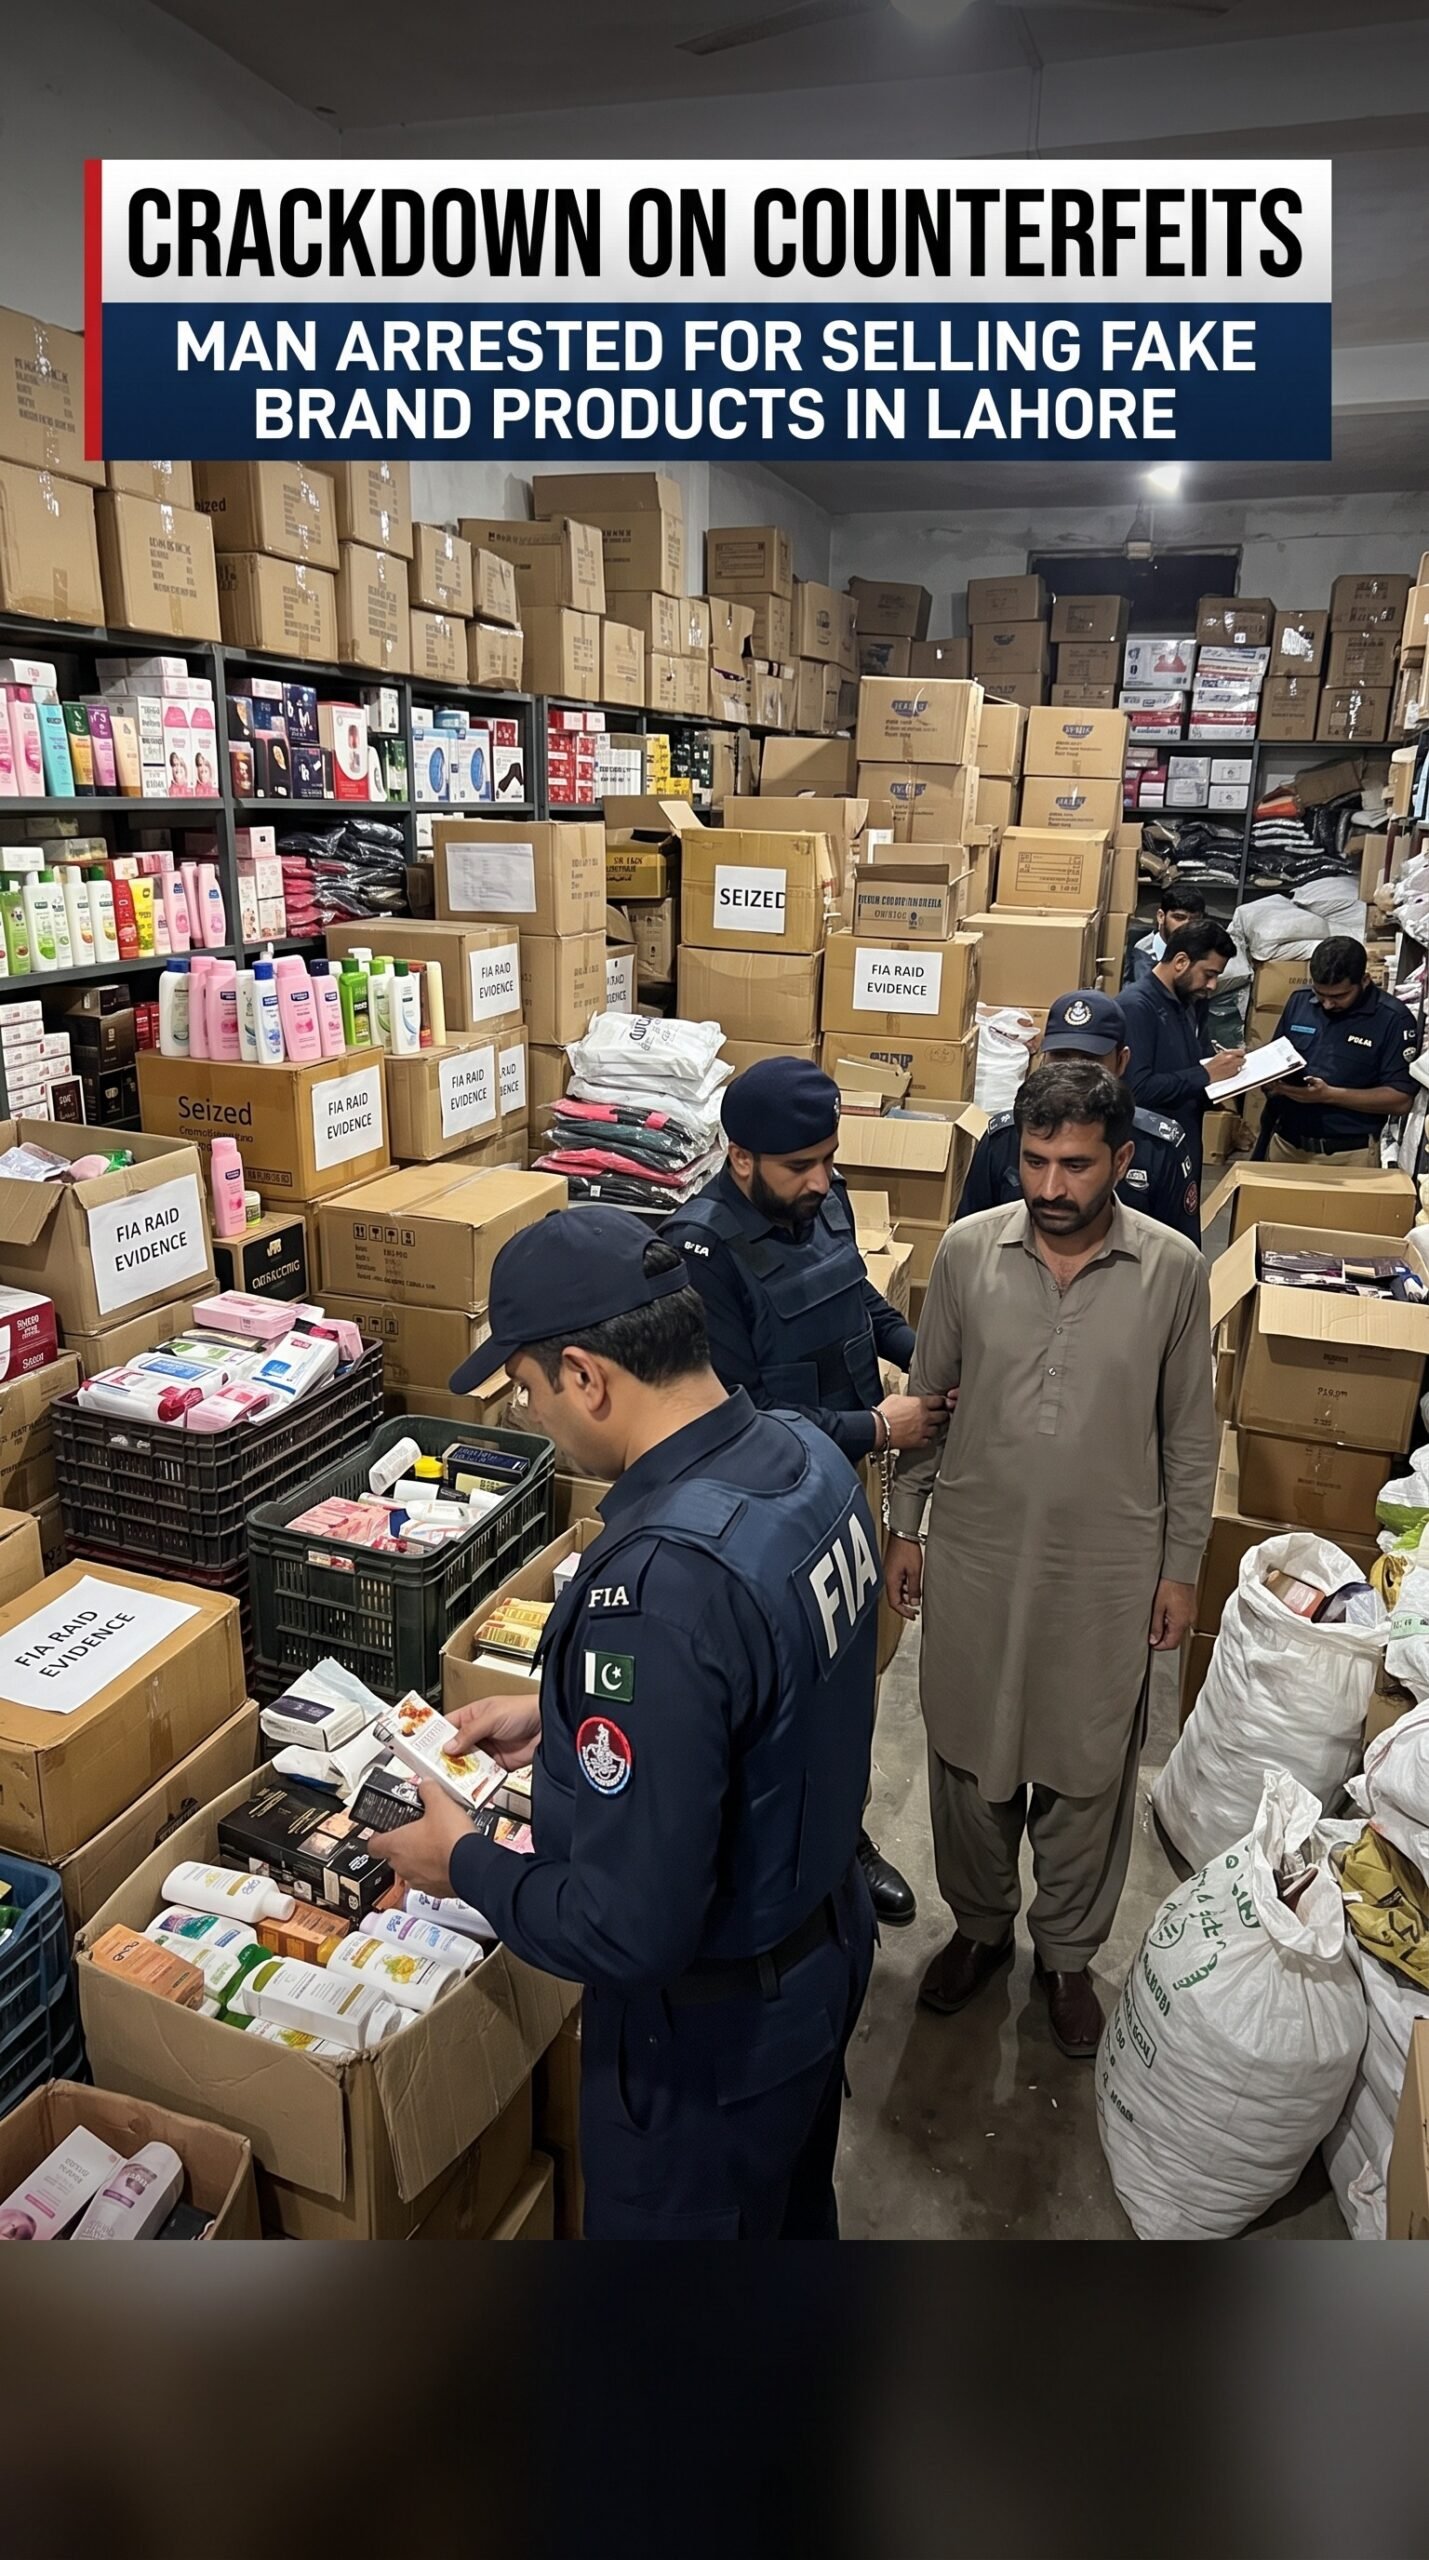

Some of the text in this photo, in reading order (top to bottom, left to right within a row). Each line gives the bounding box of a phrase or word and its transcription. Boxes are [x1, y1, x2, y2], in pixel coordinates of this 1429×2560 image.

[719, 887, 786, 909] SEIZED
[481, 966, 494, 979] FIA
[871, 964, 924, 978] FIA RAID
[867, 982, 928, 996] EVIDENCE
[451, 1068, 485, 1089] FIA RAID
[178, 1095, 252, 1126] Seized
[328, 1092, 368, 1116] FIA RAID
[450, 1087, 487, 1111] EVIDENCE
[327, 1112, 372, 1140] EVIDENCE
[116, 1207, 180, 1243] FIA RAID
[114, 1231, 188, 1272] EVIDENCE
[588, 1585, 630, 1608] FIA
[808, 1512, 878, 1660] FIA
[14, 1610, 99, 1667] FIA RAID
[39, 1612, 136, 1678] EVIDENCE
